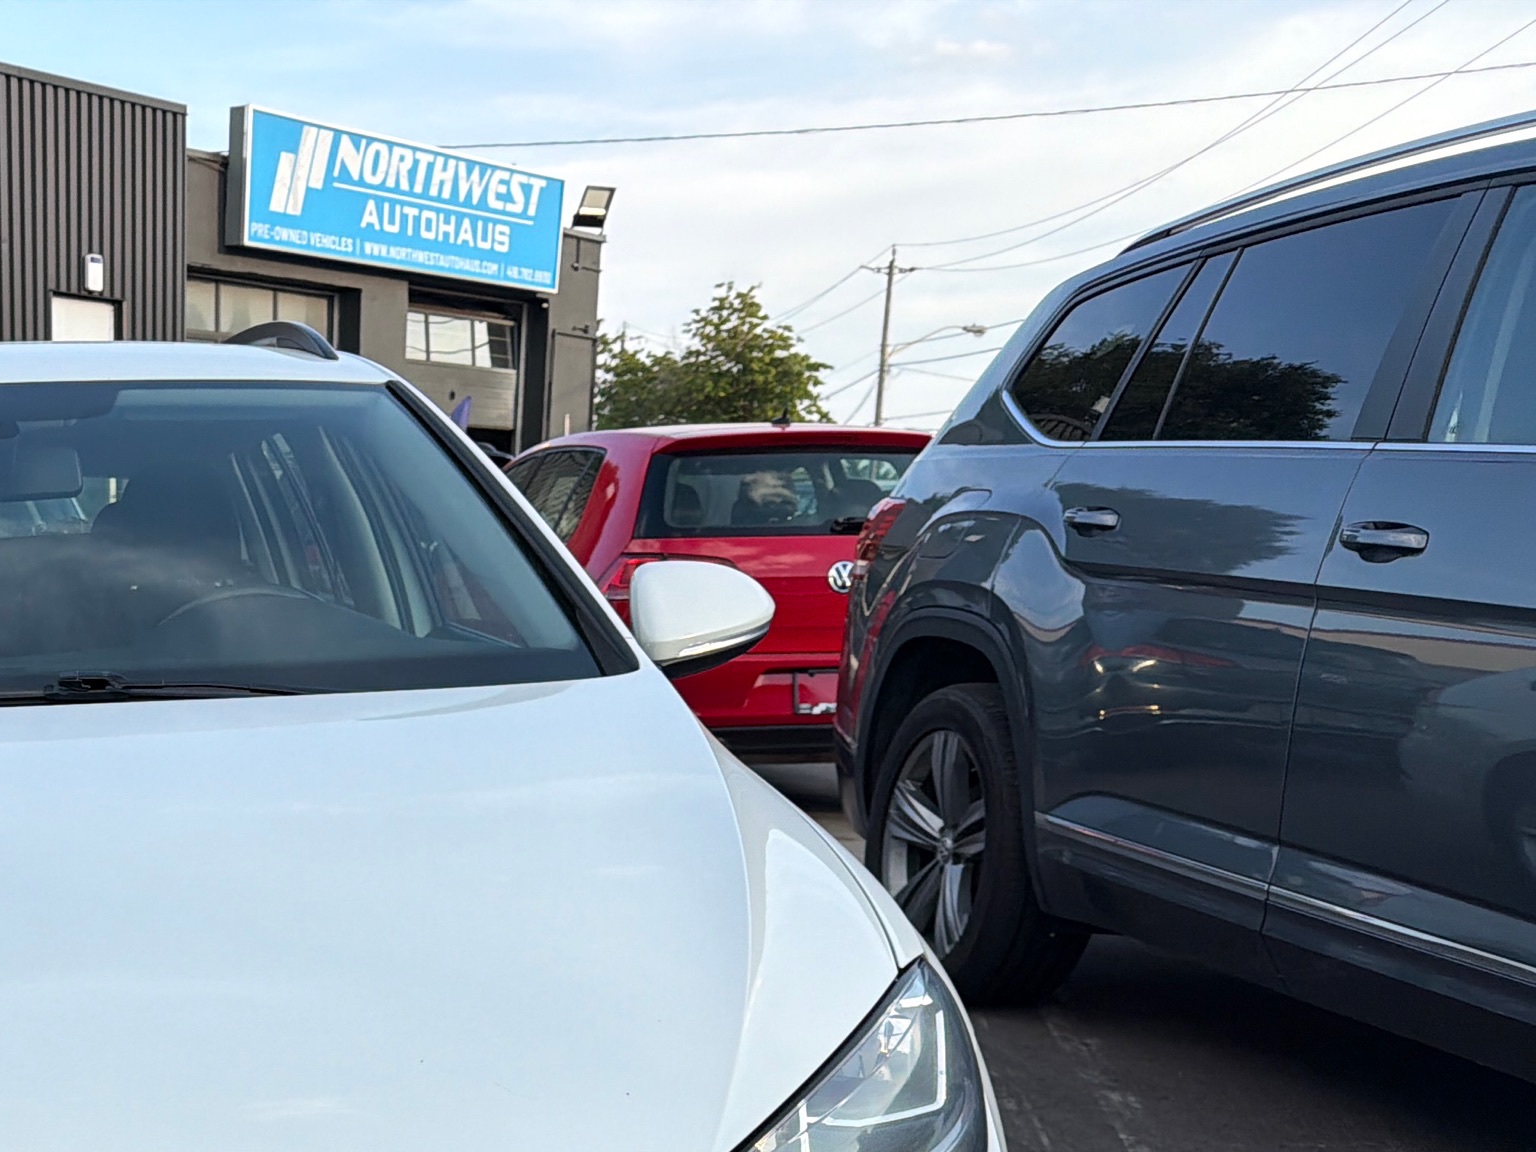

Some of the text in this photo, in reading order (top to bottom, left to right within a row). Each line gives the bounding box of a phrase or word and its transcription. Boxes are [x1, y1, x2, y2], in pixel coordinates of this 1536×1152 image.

[333, 134, 547, 217] NORTHWEST
[250, 222, 308, 246] PRE-OWNED
[309, 230, 354, 253] VEHICLES
[360, 199, 511, 253] AUTOHAUS
